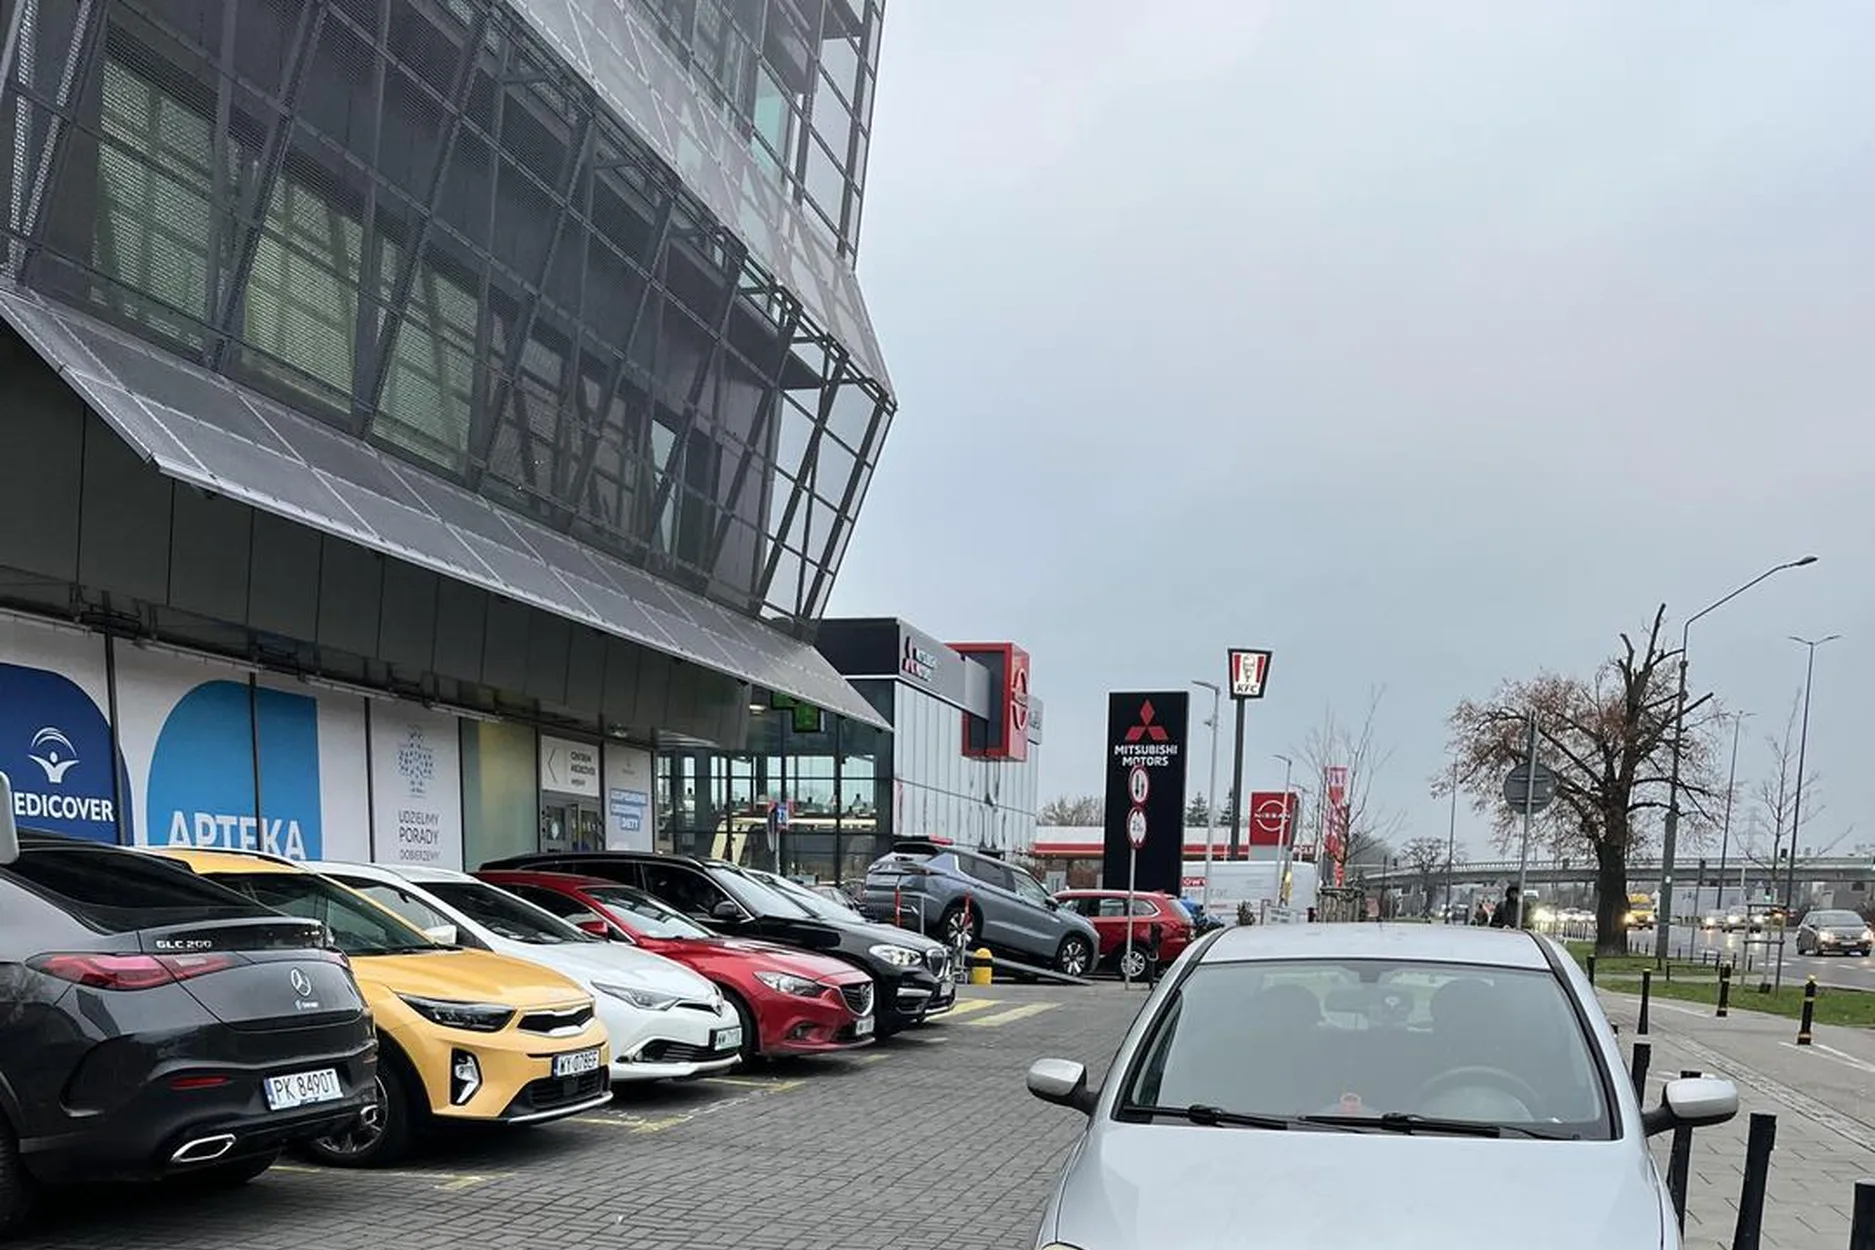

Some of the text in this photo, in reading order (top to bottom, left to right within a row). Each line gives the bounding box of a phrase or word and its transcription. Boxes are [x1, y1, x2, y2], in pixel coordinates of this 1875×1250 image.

[1236, 683, 1258, 694] KFC
[1113, 744, 1179, 756] MITSUBISHI
[1121, 756, 1170, 767] MOTORS
[13, 791, 115, 822] EDICOVER
[168, 810, 307, 861] APTEKA
[399, 825, 441, 844] PORADY
[155, 940, 213, 949] GLC 200
[273, 1078, 296, 1101] PK
[297, 1070, 336, 1097] 8490T
